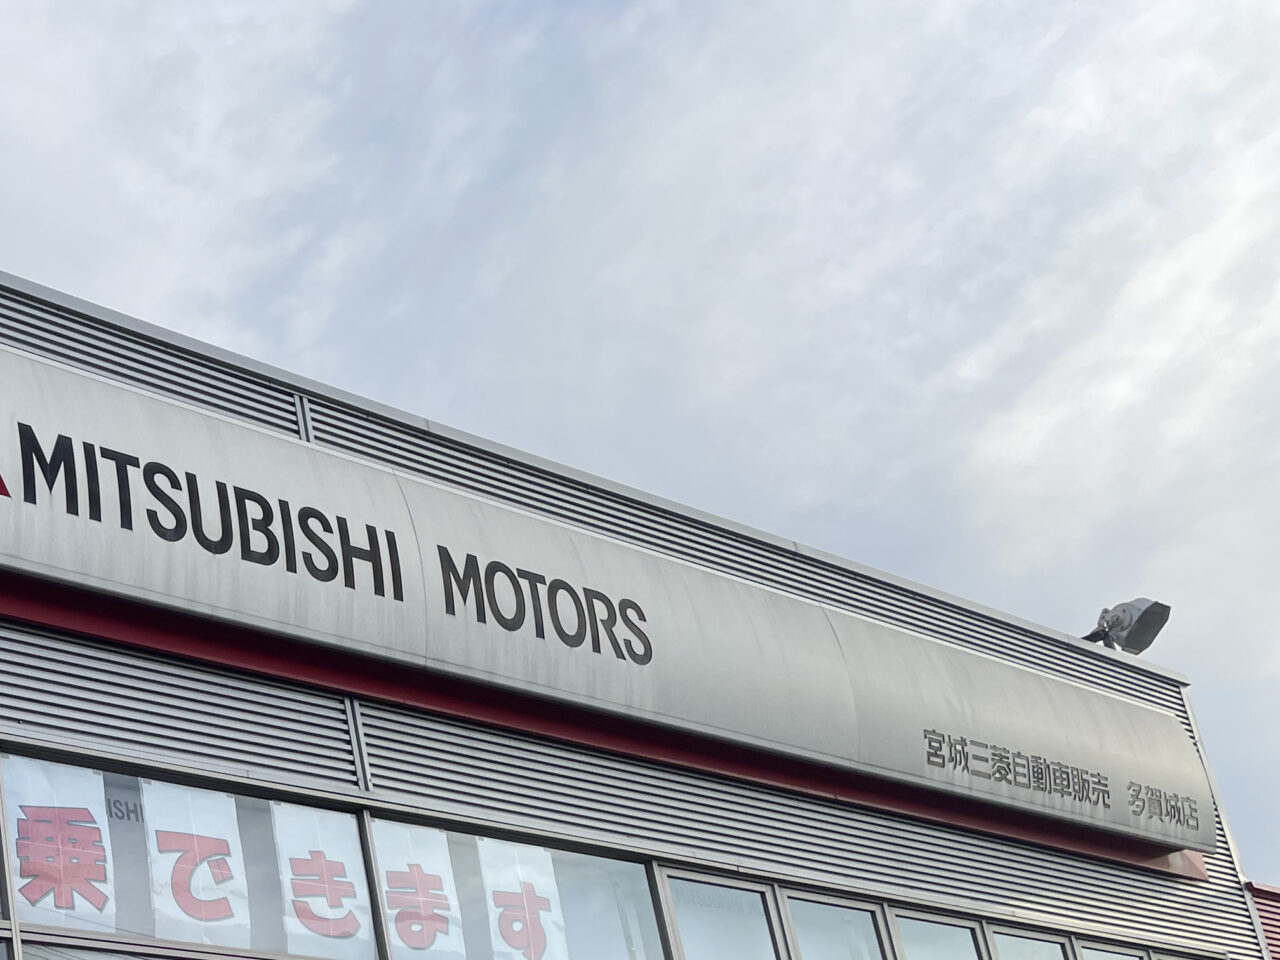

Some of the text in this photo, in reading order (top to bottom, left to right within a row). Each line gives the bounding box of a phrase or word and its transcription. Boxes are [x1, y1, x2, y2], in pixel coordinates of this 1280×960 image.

[17, 422, 653, 665] MITSUBISHI MOTORS
[923, 729, 1200, 830] 宮城三菱自動車販売 多賀城店
